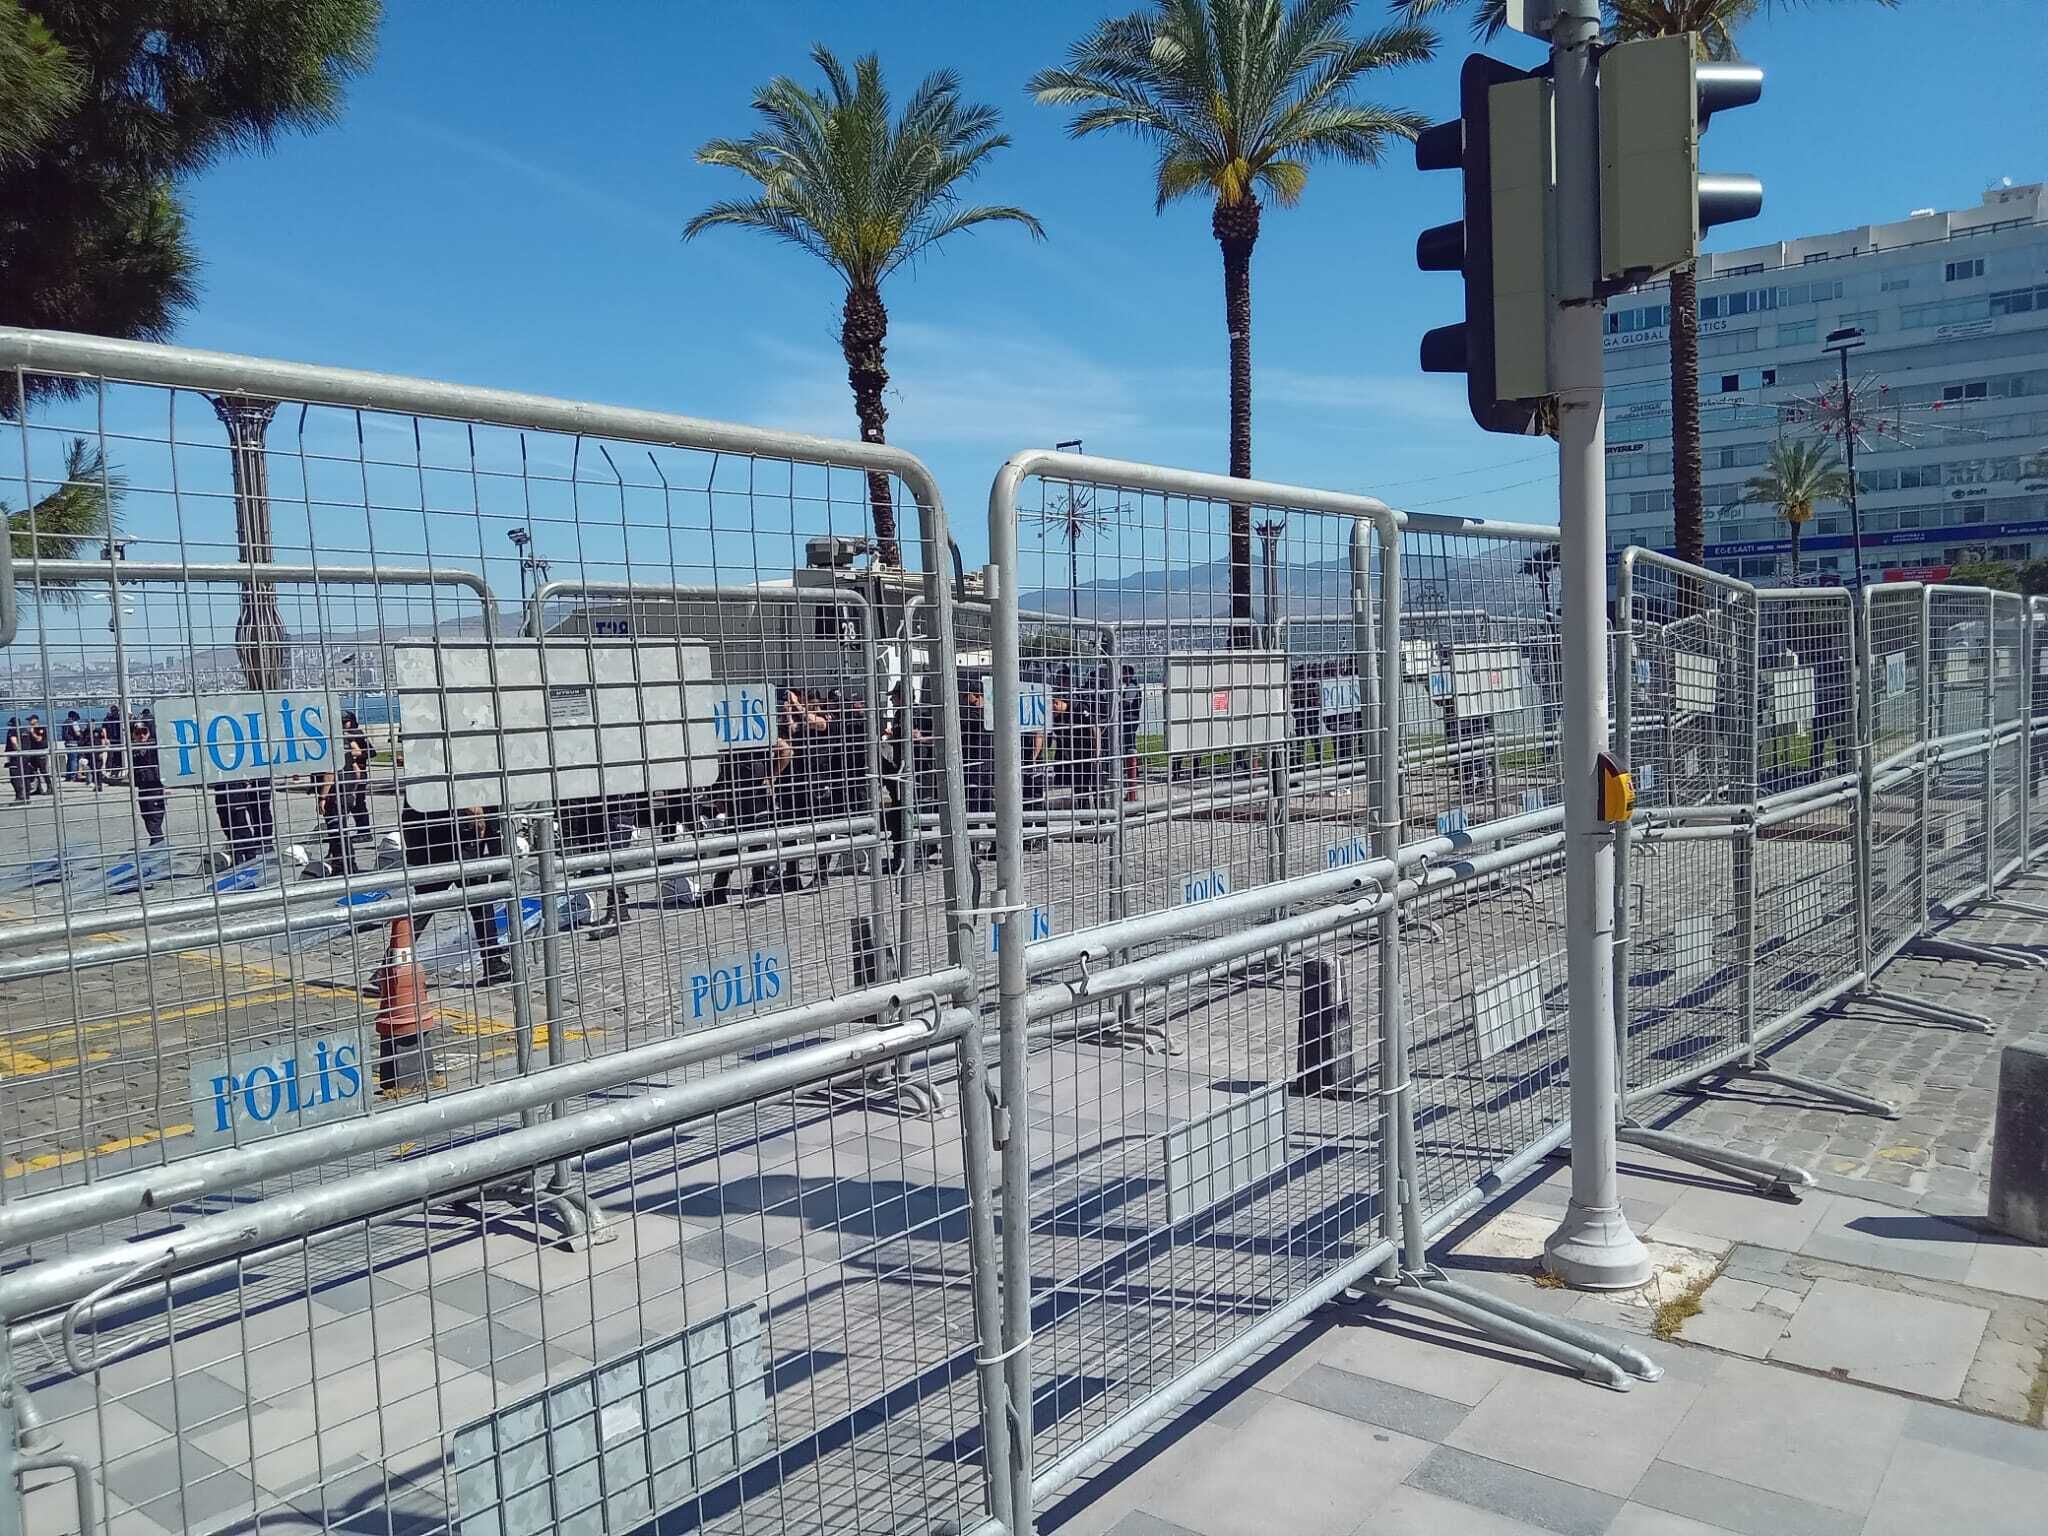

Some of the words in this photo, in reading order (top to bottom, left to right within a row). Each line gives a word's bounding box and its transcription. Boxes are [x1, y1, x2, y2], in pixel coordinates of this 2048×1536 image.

[1621, 330, 1664, 344] GLOBAL
[172, 698, 328, 776] POLİS
[714, 690, 766, 742] LİS
[691, 951, 780, 1018] POLİS
[209, 1040, 360, 1133] POLİS
